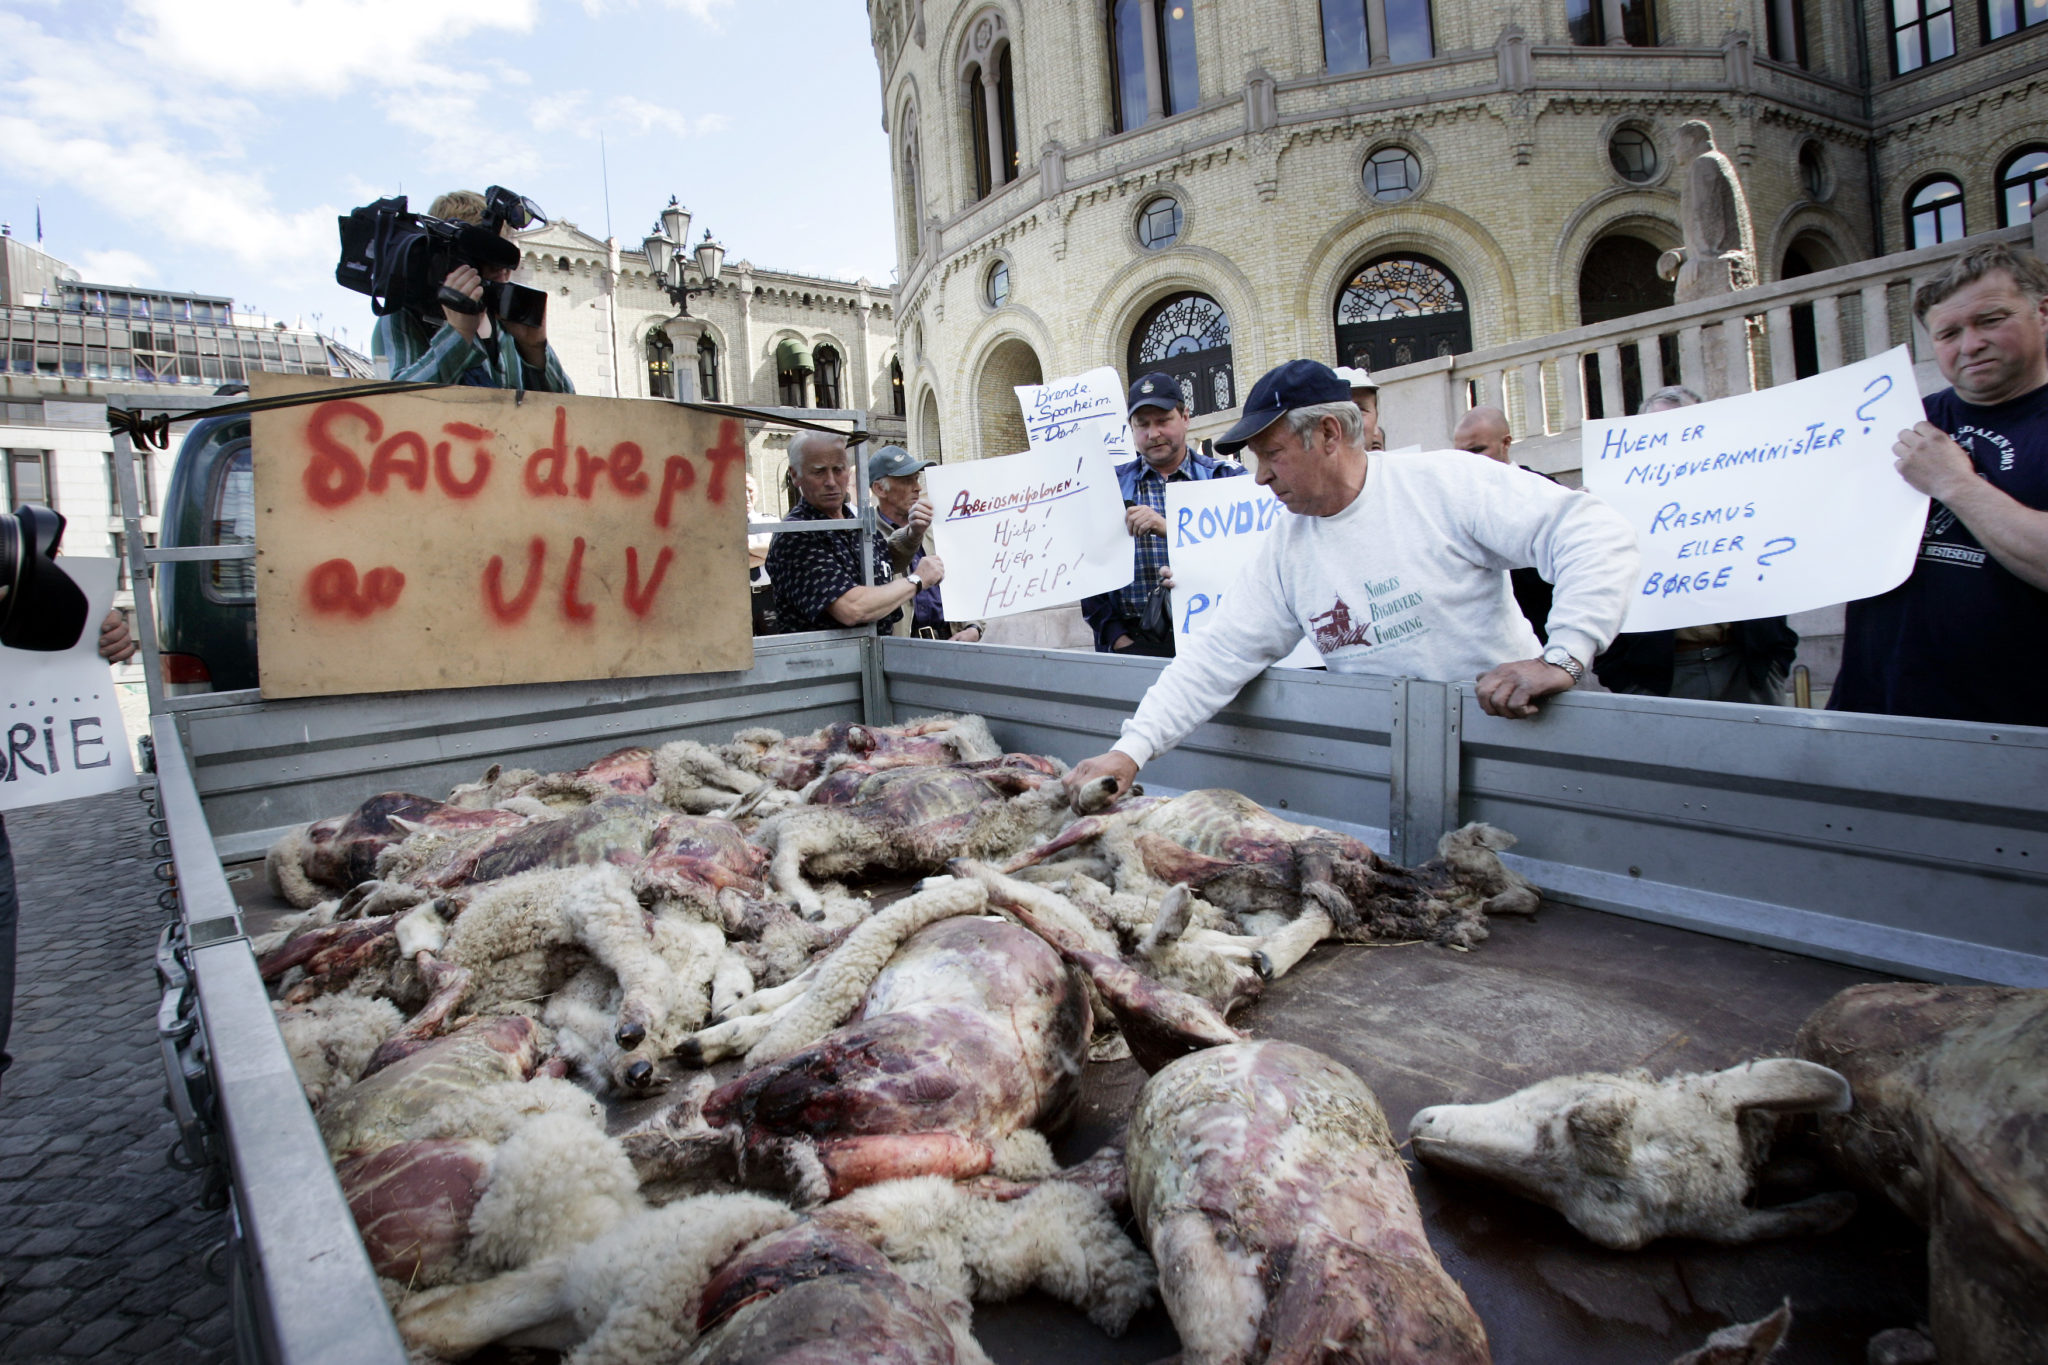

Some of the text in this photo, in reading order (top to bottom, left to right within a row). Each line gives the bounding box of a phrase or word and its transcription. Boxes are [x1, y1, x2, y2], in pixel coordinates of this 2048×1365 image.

[1682, 425, 1704, 442] ER
[523, 406, 746, 528] drept
[1650, 502, 1755, 534] RASMUS
